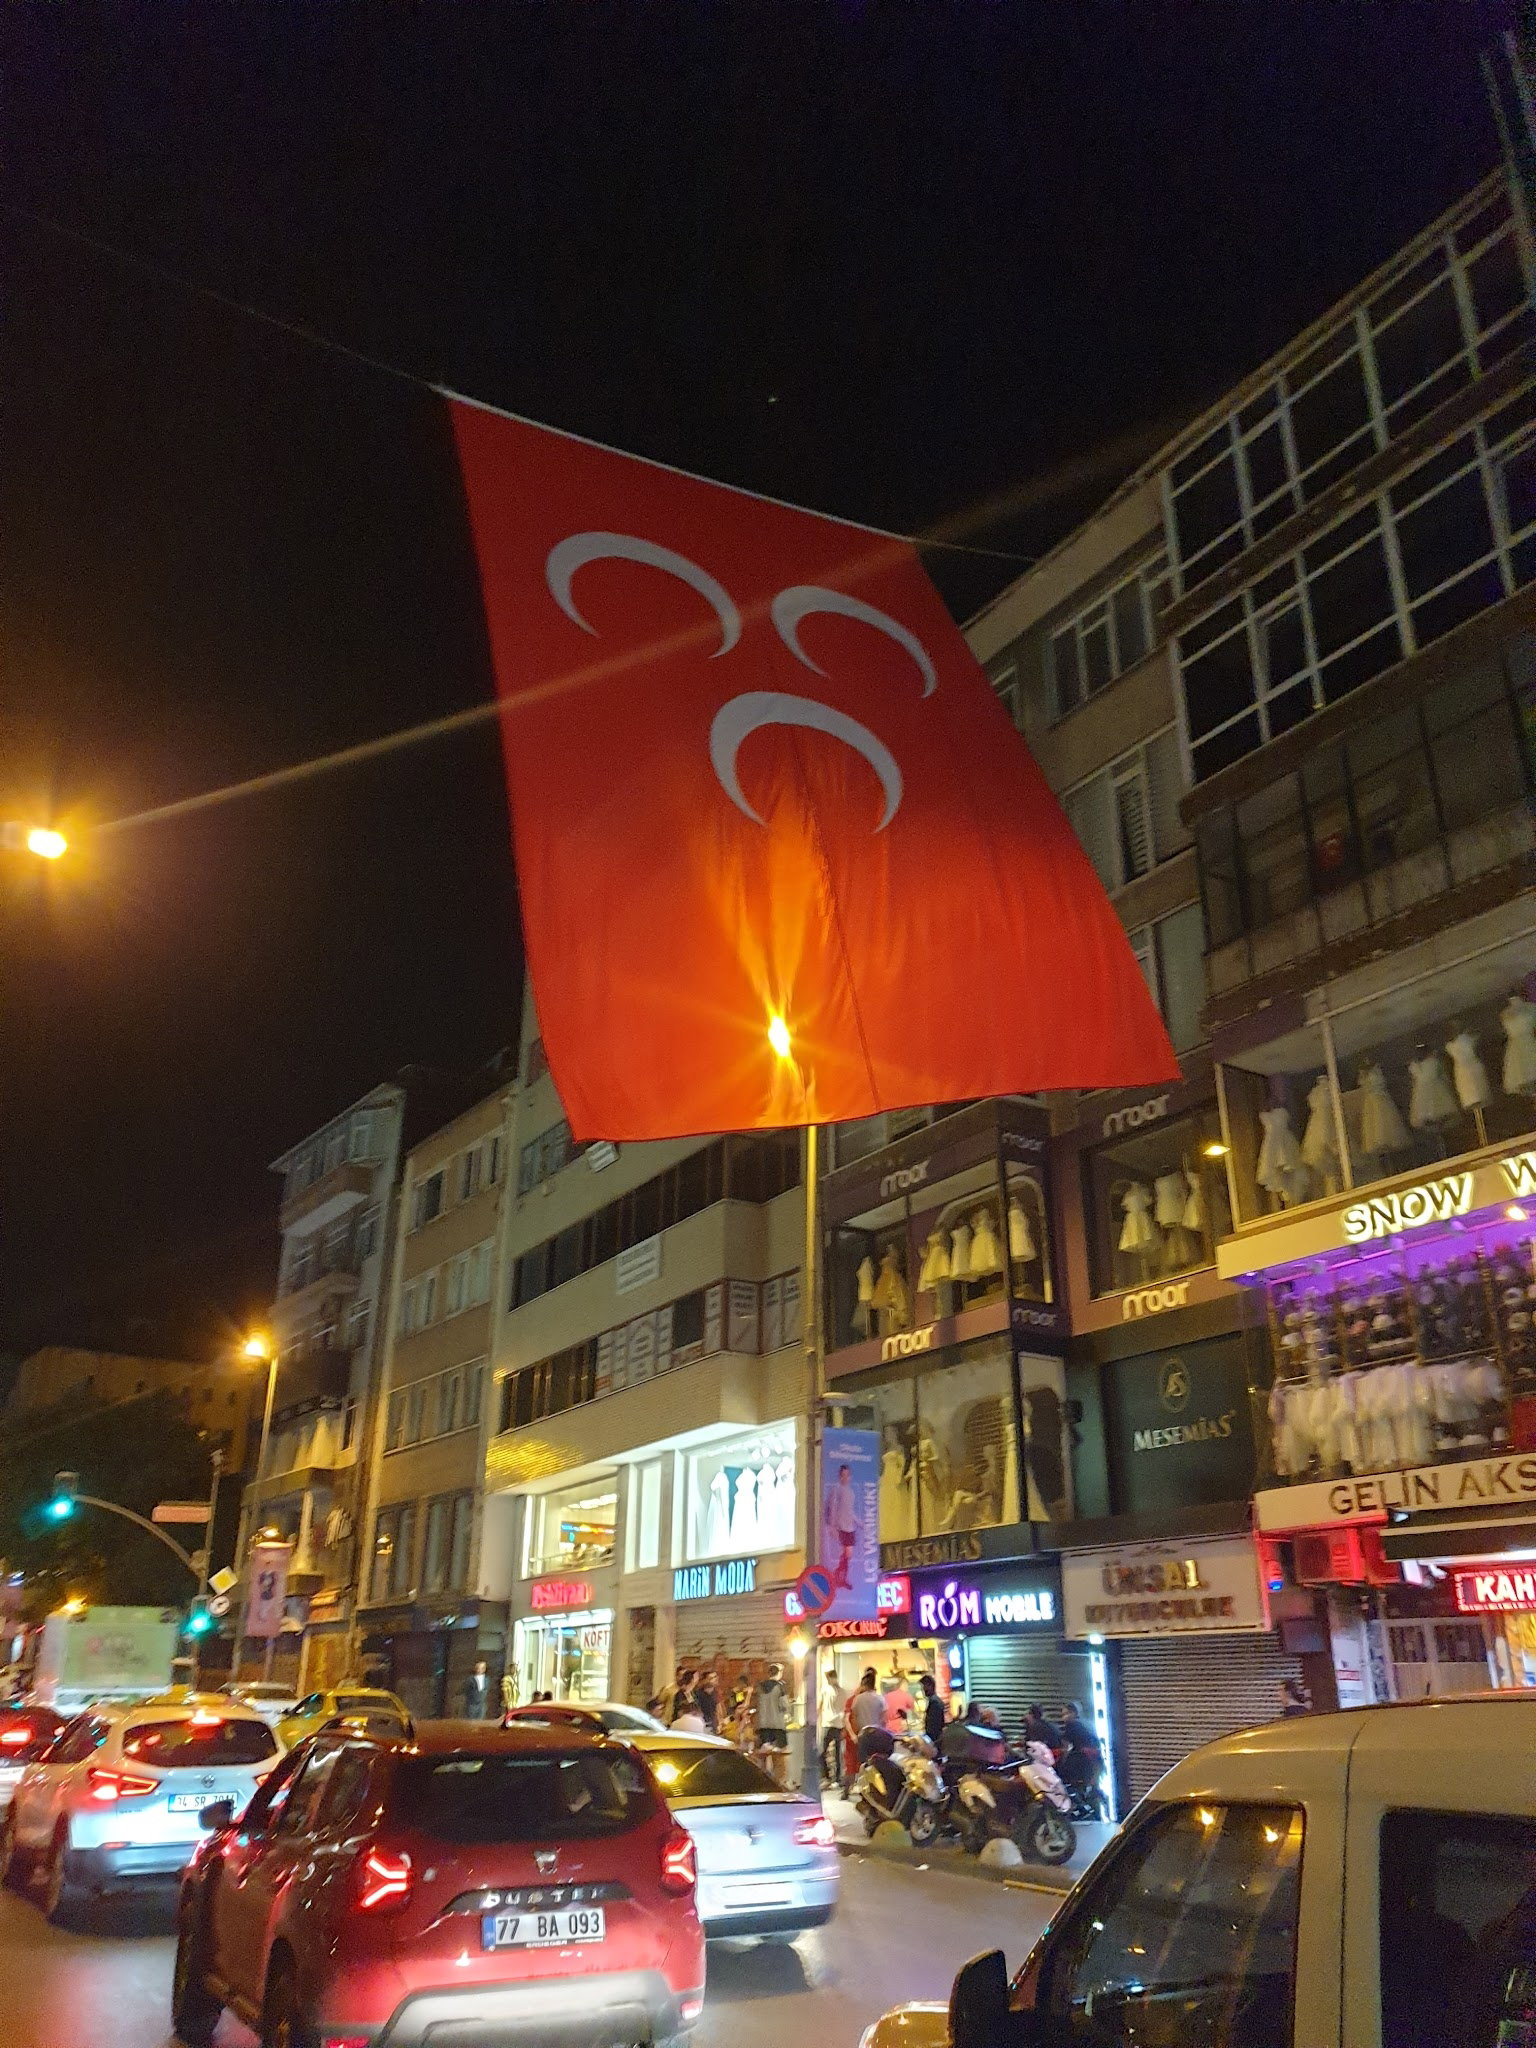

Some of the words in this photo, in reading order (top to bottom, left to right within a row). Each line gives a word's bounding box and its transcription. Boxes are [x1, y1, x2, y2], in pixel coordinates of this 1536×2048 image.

[1103, 1094, 1170, 1138] moor
[880, 1156, 932, 1198] moor
[1343, 1172, 1474, 1241] SNOW
[1122, 1281, 1191, 1320] moor
[881, 1326, 934, 1361] moor
[1329, 1470, 1440, 1514] GELİN
[715, 1559, 755, 1596] MODA
[985, 1592, 1055, 1624] MOBILE
[497, 1918, 520, 1941] 77
[538, 1915, 559, 1938] BA
[568, 1912, 600, 1936] 093
